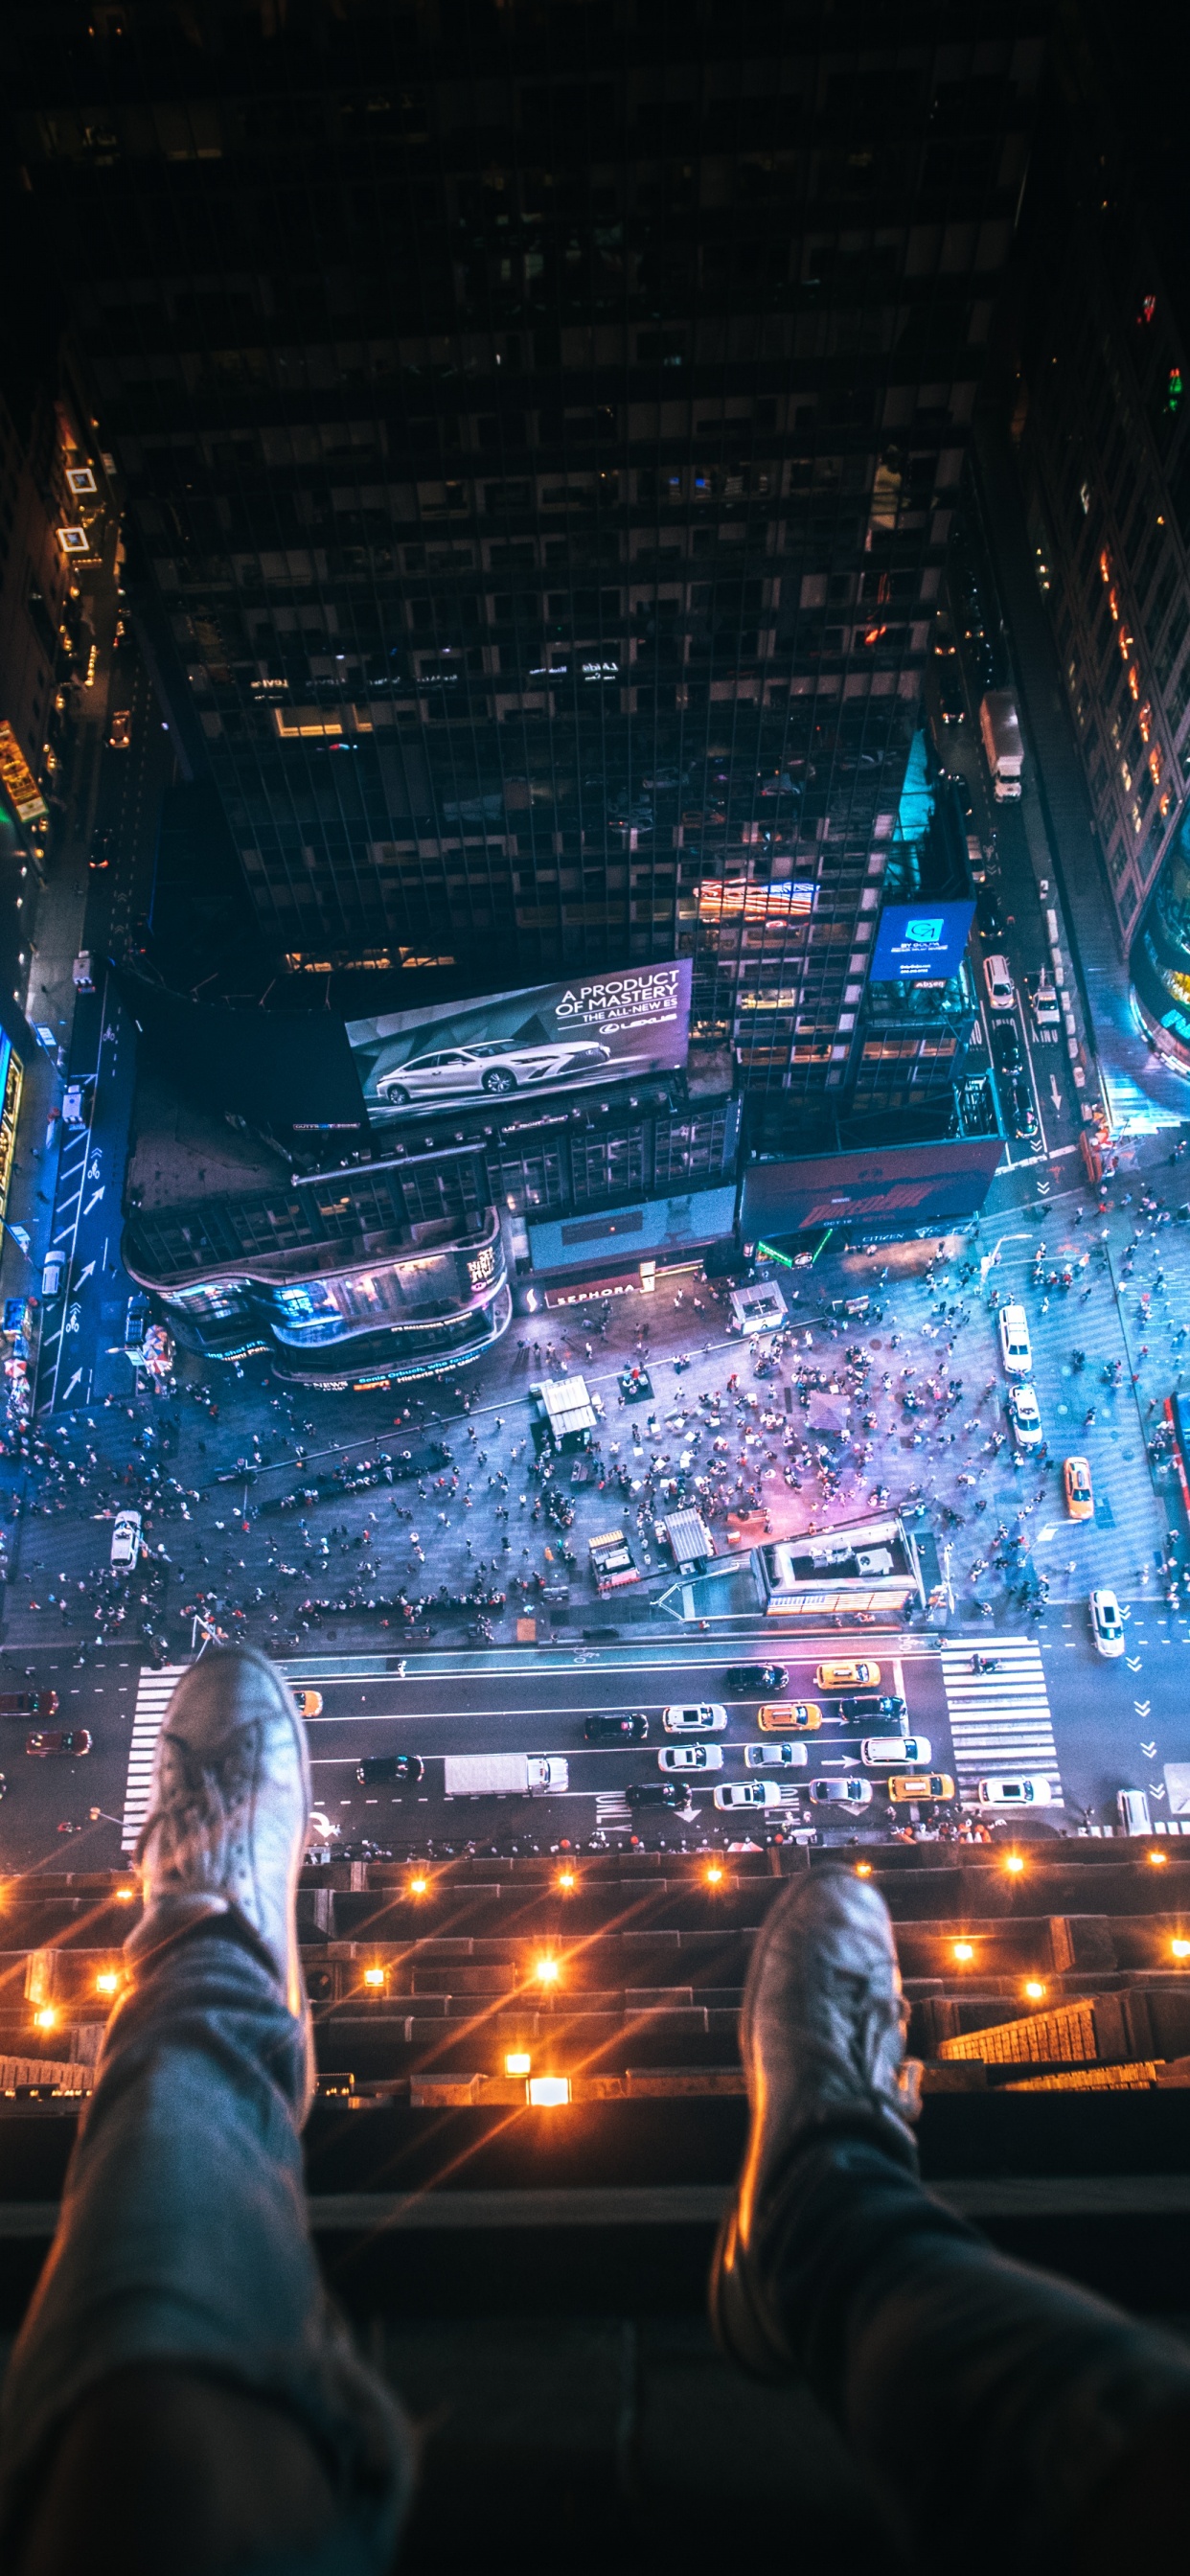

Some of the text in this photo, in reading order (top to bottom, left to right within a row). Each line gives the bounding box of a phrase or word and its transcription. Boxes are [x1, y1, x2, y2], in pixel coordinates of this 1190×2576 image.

[561, 969, 679, 1002] A PRODUCT
[556, 982, 678, 1016] OF MASTERY
[583, 998, 677, 1023] THE ALL-NEW ES
[621, 1013, 677, 1029] LEXUS
[862, 1232, 904, 1243] CITIZEN
[558, 1284, 634, 1305] SEPHORA
[427, 1360, 447, 1370] who
[595, 1794, 632, 1832] ONLY
